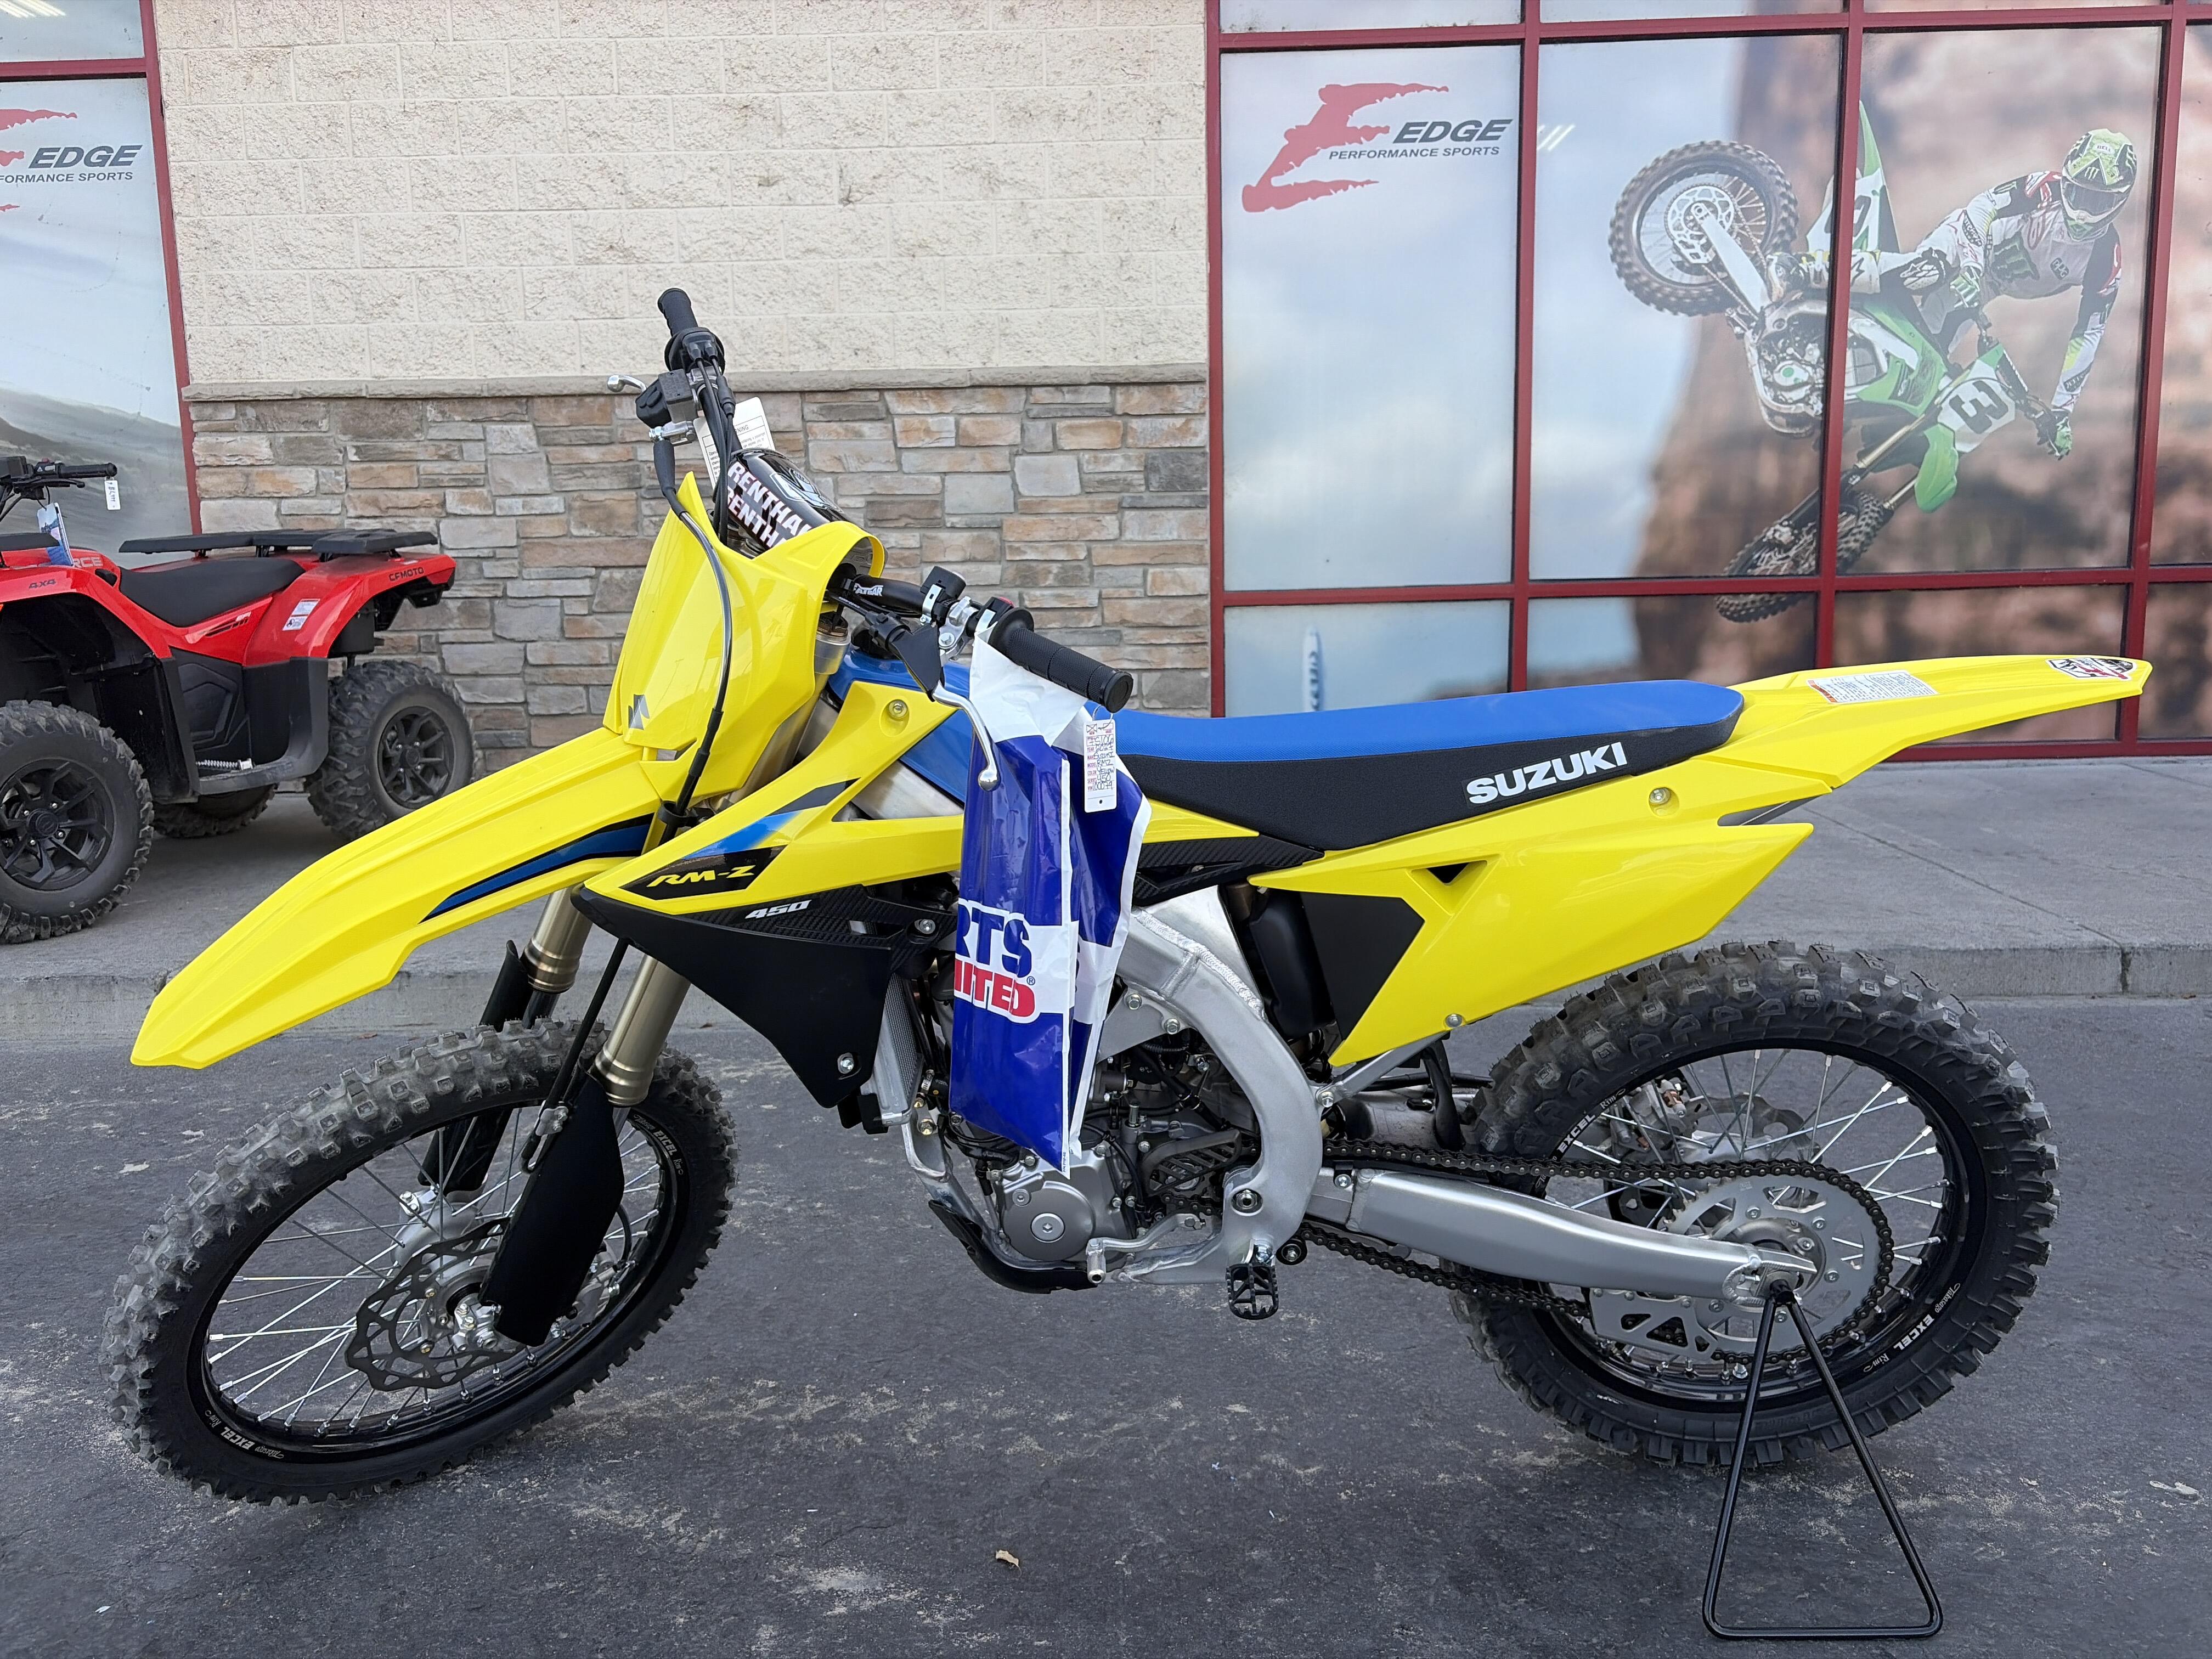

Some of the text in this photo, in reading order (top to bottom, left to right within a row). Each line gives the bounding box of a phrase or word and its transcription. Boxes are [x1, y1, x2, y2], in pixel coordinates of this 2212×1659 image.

[1393, 119, 1513, 144] EDGE
[28, 145, 143, 168] EDGE
[1329, 146, 1499, 160] PERFORMANCE SPORTS
[78, 172, 133, 181] SPORTS
[1949, 380, 2008, 434] 3
[388, 567, 424, 582] CFMOTO
[1466, 742, 1628, 804] SUZUKI
[647, 865, 756, 888] RM-Z
[744, 899, 812, 919] 450
[653, 1130, 678, 1155] EXCEL
[1557, 1114, 1596, 1153] EXCEL
[1935, 1283, 1961, 1314] Takasago
[1893, 1316, 1936, 1351] EXCEL
[221, 1426, 255, 1450] EXCEL
